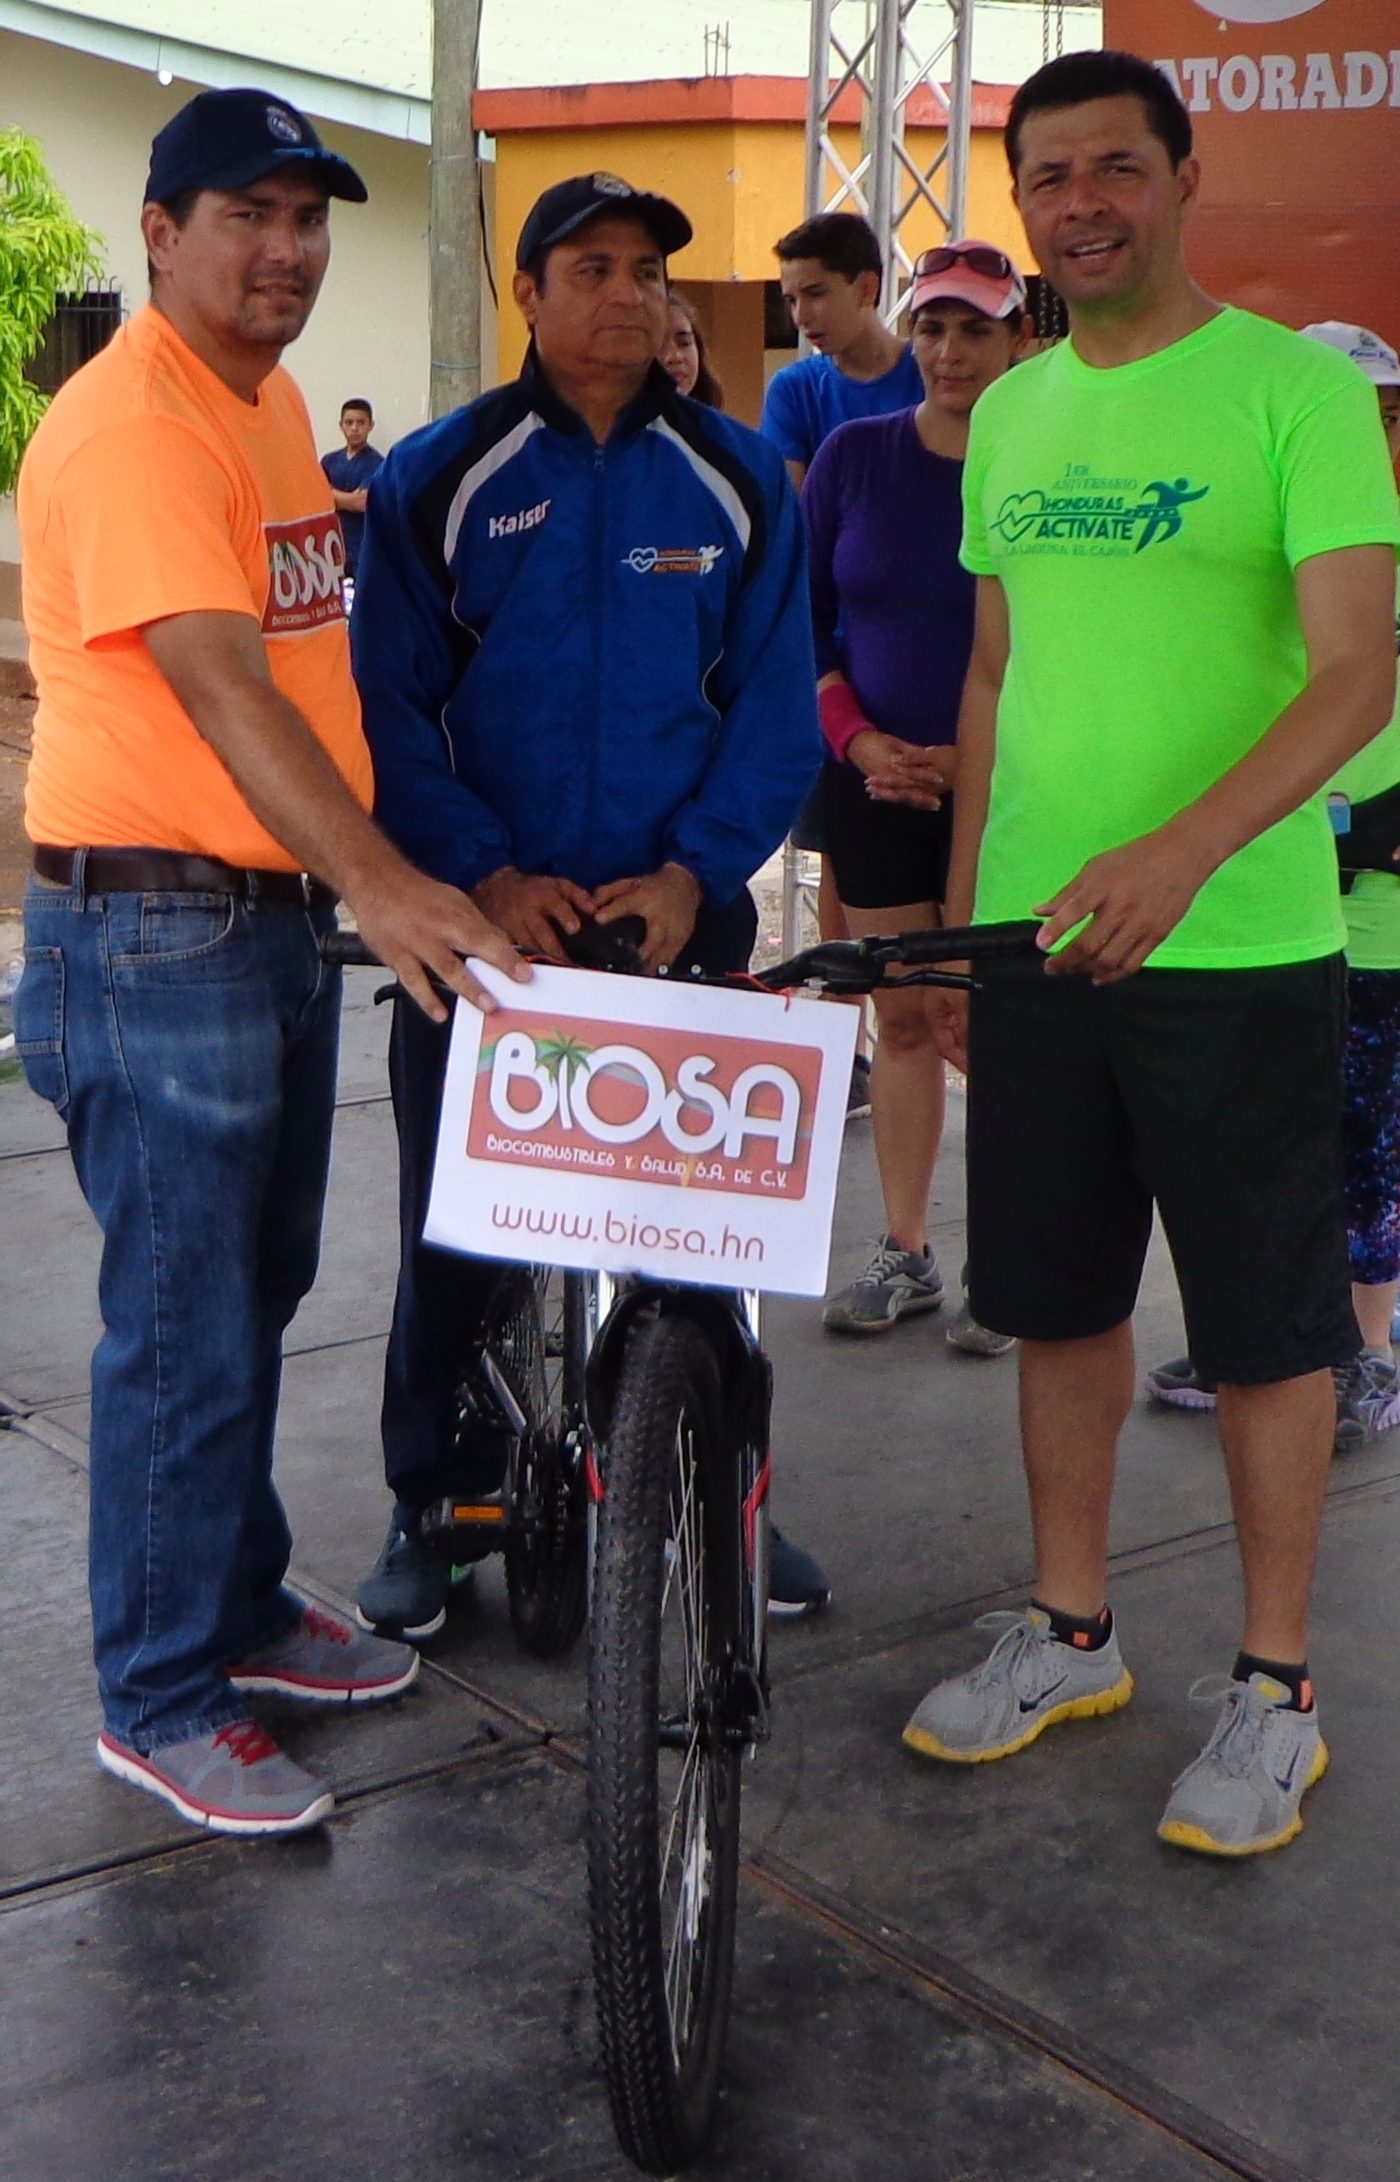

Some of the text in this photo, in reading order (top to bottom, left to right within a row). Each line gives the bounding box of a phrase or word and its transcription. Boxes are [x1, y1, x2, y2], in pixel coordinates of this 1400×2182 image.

[488, 499, 551, 540] Kaiser
[1044, 496, 1125, 512] HONDURAS
[1035, 517, 1136, 541] ACTIVATE
[489, 1031, 801, 1164] BIOSA
[486, 1133, 616, 1168] BIOCOMBUSTIBLES
[624, 1154, 634, 1170] Y
[640, 1154, 688, 1177] SALUD
[695, 1161, 726, 1182] S.A.
[733, 1168, 753, 1185] DE
[491, 1203, 765, 1262] www.biosa.hn
